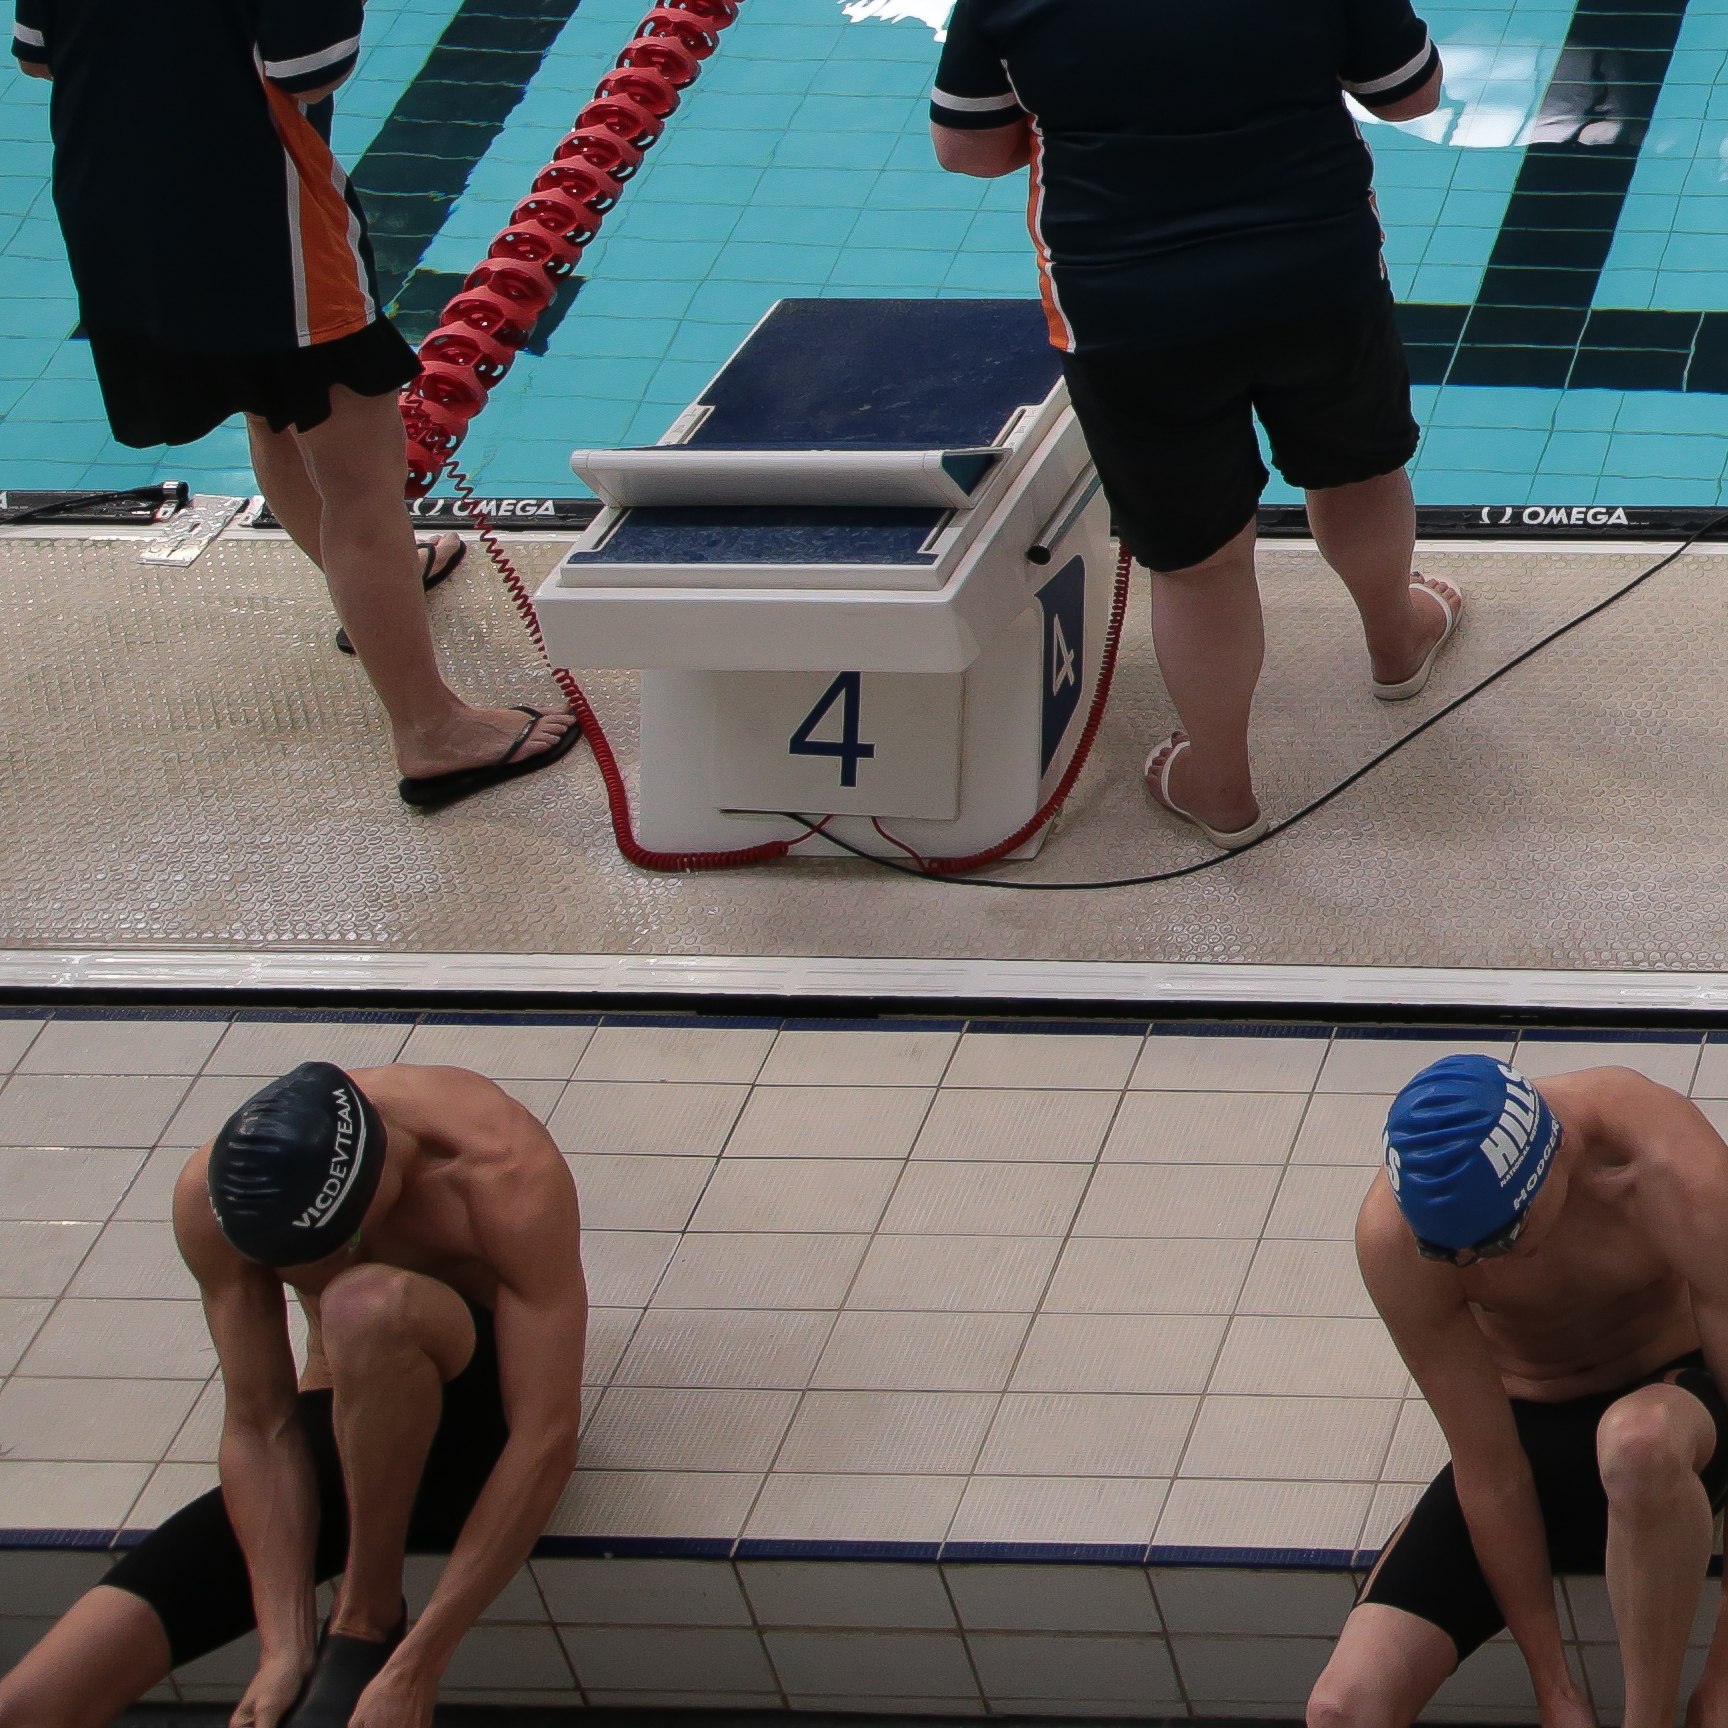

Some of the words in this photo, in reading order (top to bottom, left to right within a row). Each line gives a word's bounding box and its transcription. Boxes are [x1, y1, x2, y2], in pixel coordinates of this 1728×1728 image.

[1522, 506, 1629, 525] OMEGA
[1053, 615, 1076, 699] 4
[788, 671, 875, 788] 4
[291, 1087, 355, 1228] VICDEVTEAM
